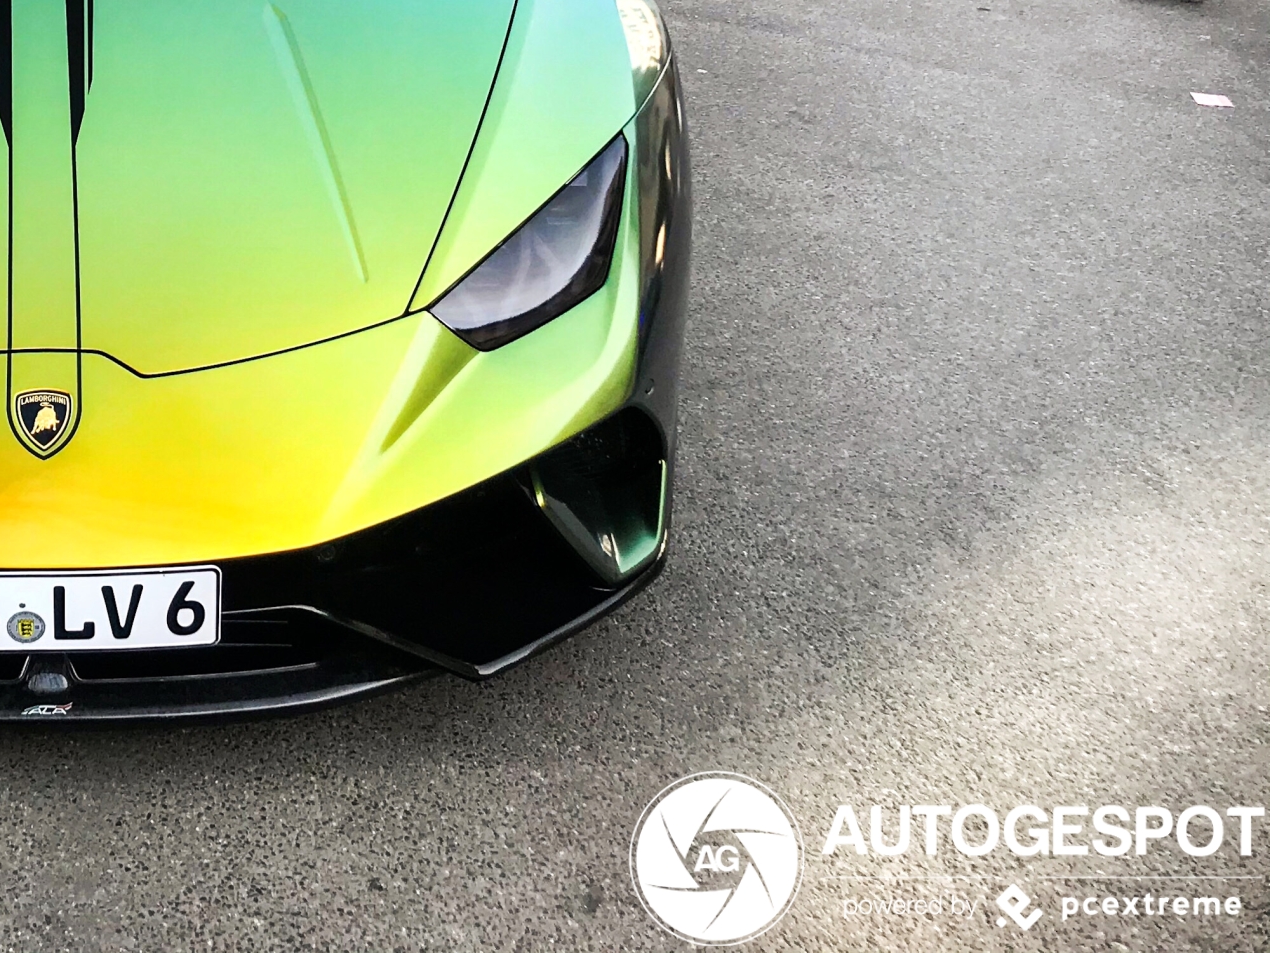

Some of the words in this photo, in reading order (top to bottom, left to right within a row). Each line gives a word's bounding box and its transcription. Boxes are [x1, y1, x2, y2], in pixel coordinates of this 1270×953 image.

[20, 394, 67, 406] LAMBORGHINI
[52, 583, 144, 641] LV
[166, 580, 206, 636] 6
